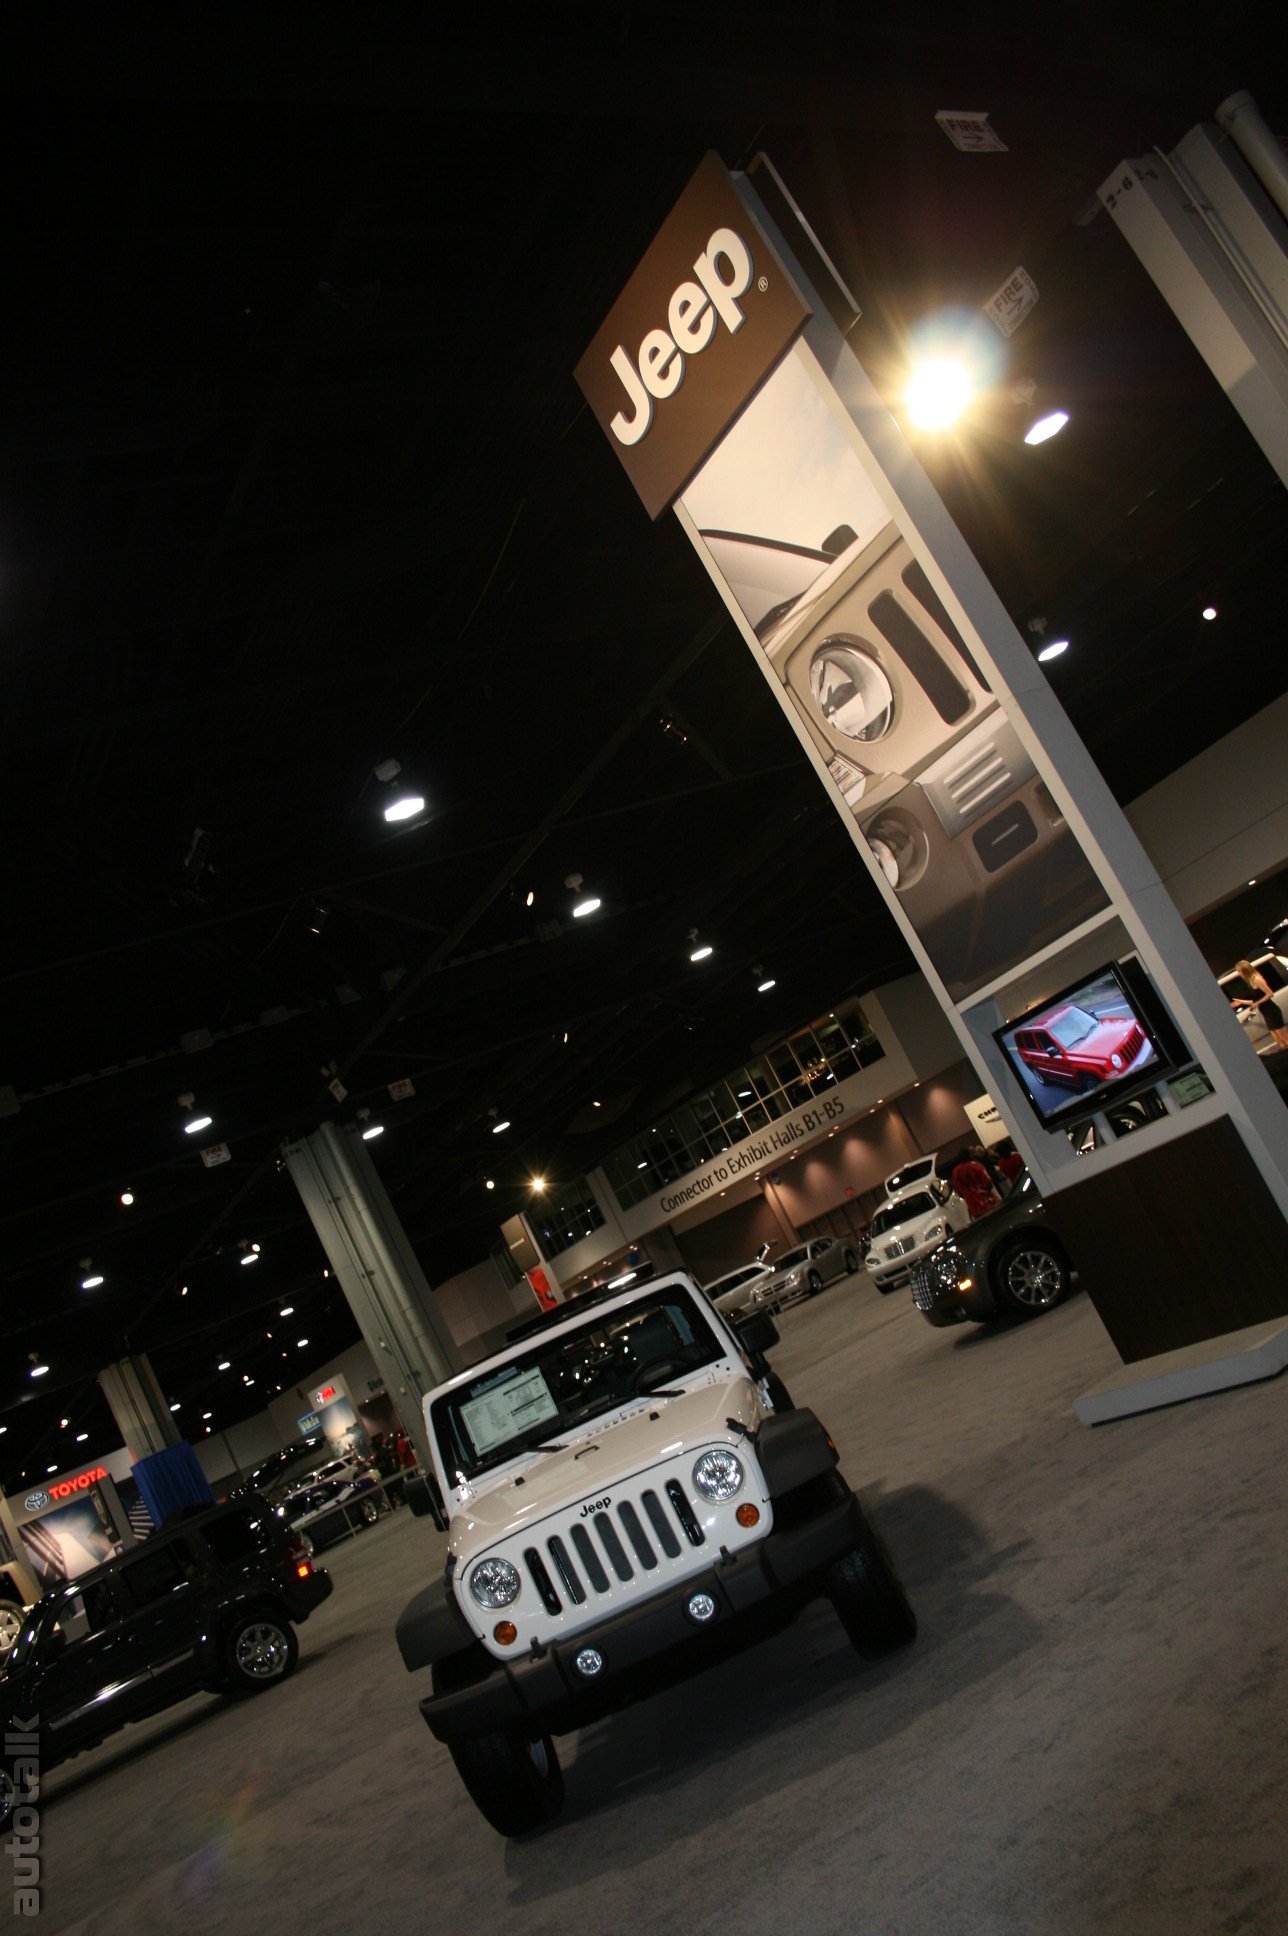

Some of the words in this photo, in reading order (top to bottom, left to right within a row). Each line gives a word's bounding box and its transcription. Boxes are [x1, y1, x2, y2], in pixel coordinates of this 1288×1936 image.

[994, 276, 1023, 313] FIRE
[610, 227, 754, 446] Jeep
[660, 1177, 714, 1213] Connector
[713, 1167, 728, 1182] to
[726, 1141, 773, 1175] Exhibit
[770, 1121, 805, 1153] Halls
[803, 1096, 846, 1132] B1-B5
[48, 1465, 108, 1501] TOYOTA
[579, 1494, 611, 1518] Jeep
